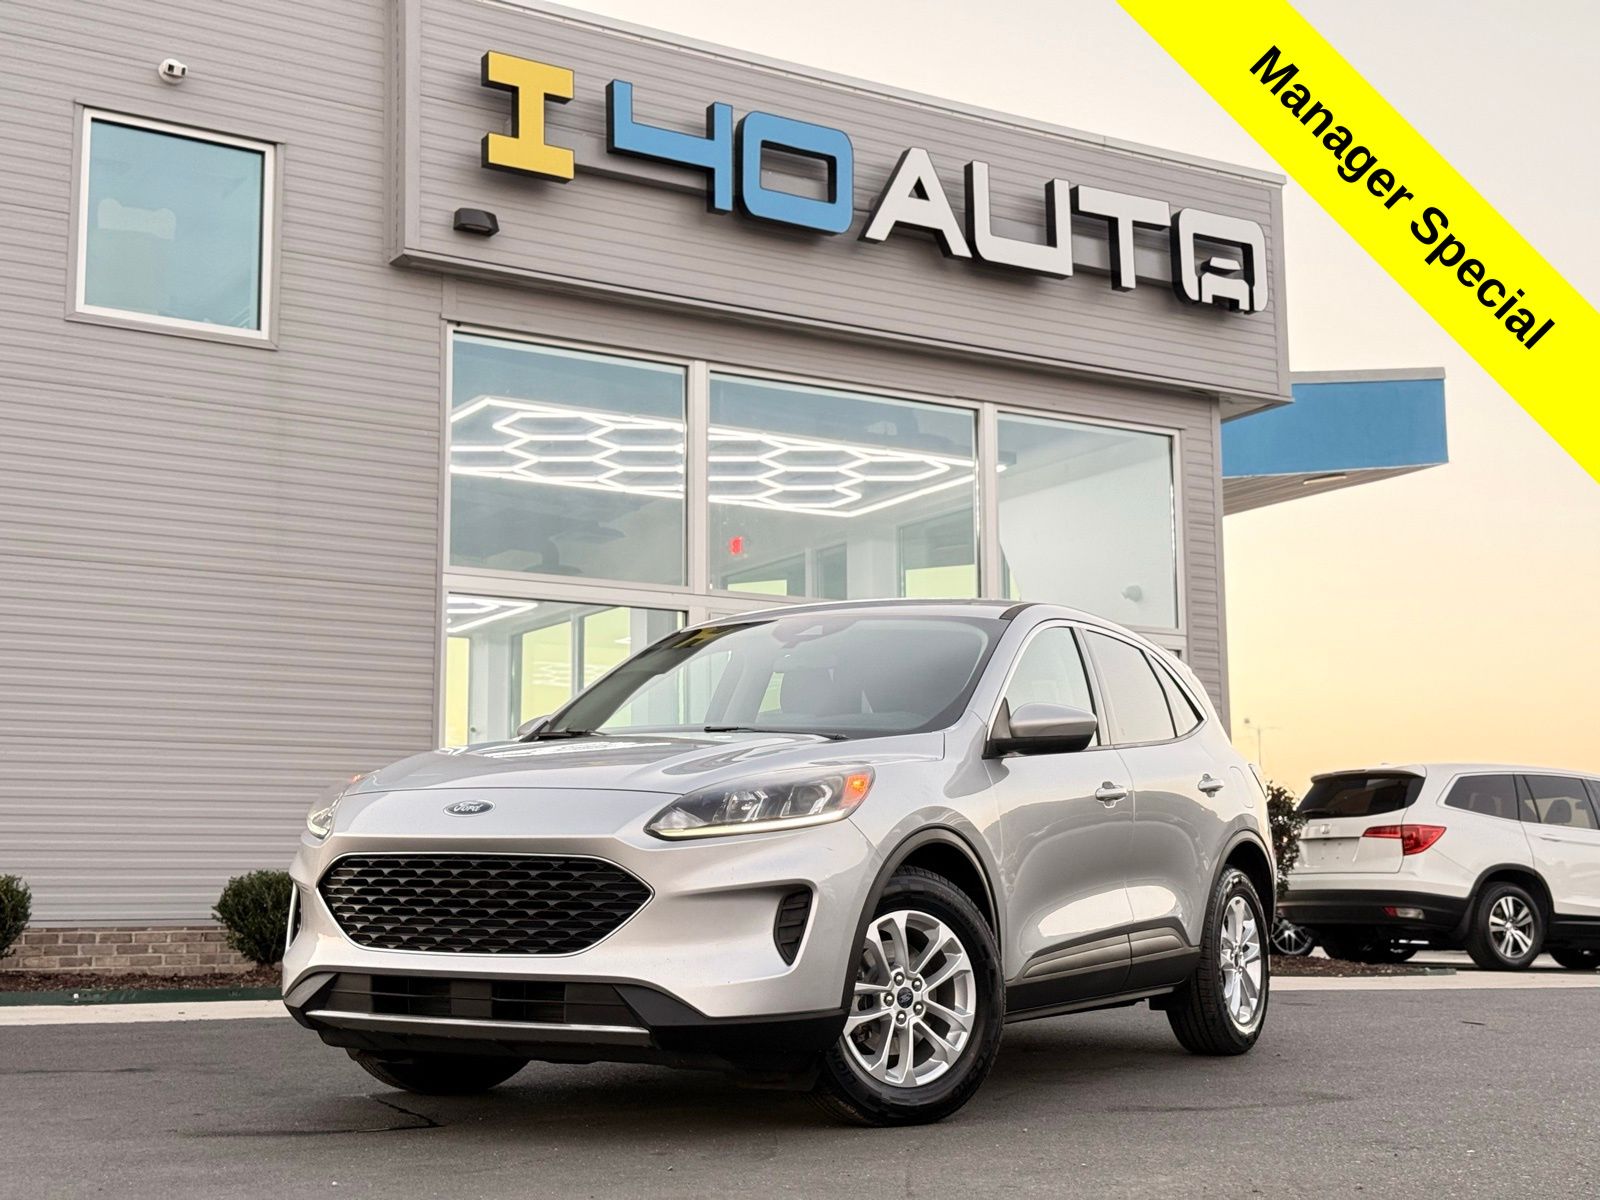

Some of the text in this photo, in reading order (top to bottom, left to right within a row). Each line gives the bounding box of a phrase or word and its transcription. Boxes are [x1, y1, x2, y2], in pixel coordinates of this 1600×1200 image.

[483, 50, 1268, 314] I 40 AUTO
[453, 801, 484, 812] Ford
